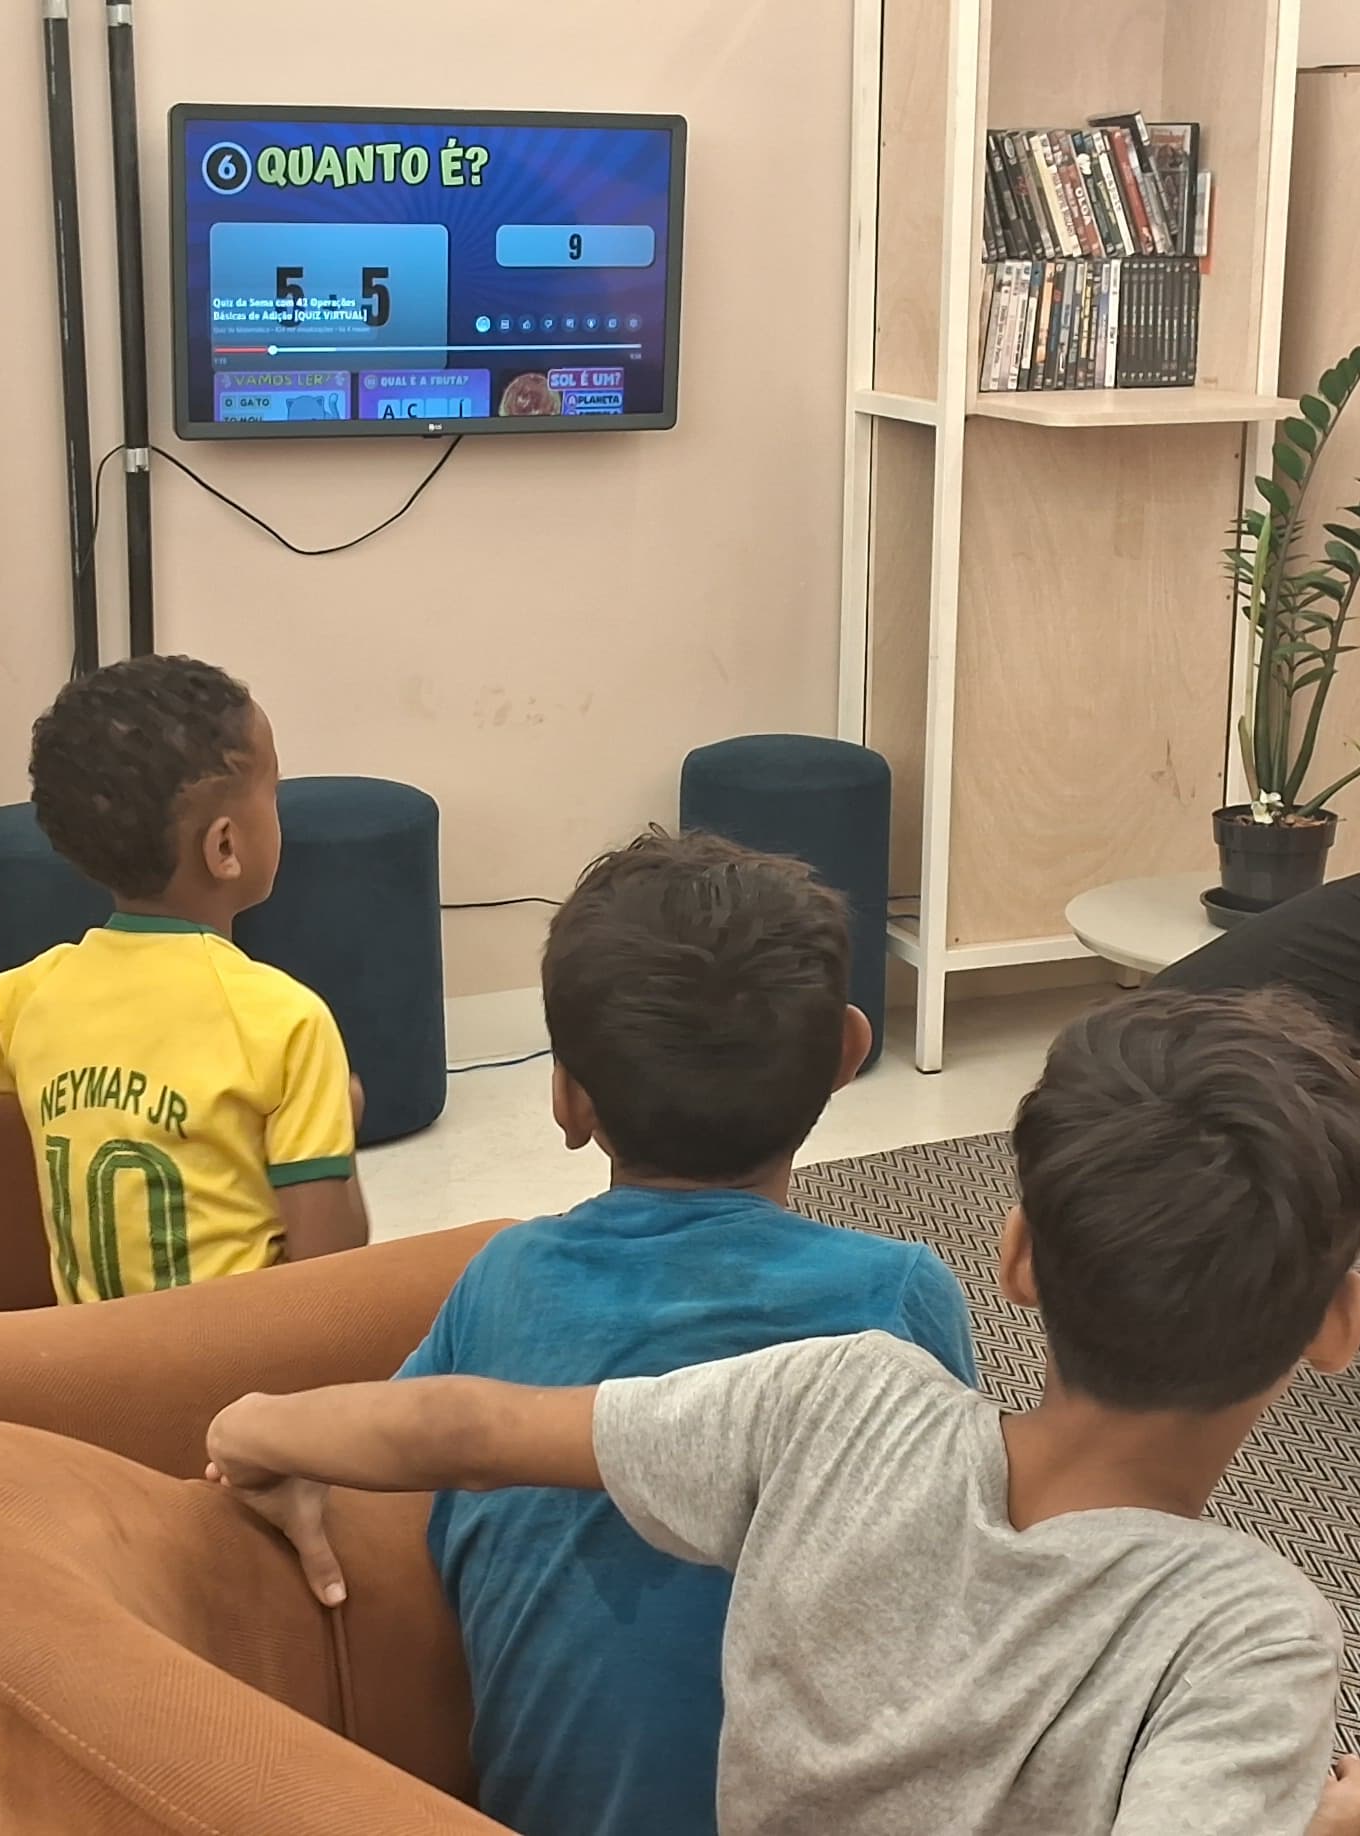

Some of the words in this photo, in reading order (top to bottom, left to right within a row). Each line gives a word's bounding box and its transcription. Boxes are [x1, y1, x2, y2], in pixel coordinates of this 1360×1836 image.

[218, 156, 236, 179] 6
[256, 141, 429, 188] QUANTO
[441, 138, 490, 187] É?
[569, 233, 582, 261] 9
[213, 298, 234, 308] Quiz
[275, 299, 294, 308] com
[310, 297, 356, 310] Operações
[275, 266, 304, 327] 5
[362, 266, 391, 327] 5
[213, 310, 246, 321] Básicas
[248, 311, 260, 321] de
[262, 310, 292, 322] Adição
[294, 310, 321, 322] [QUIZ
[324, 310, 368, 322] VIRTUAL]
[234, 375, 292, 386] VAMOS
[381, 375, 407, 387] QUAL
[420, 375, 426, 385] A
[430, 375, 469, 386] FRUTA?
[550, 373, 576, 387] SOL
[580, 370, 589, 386] É
[593, 372, 621, 386] UM?
[577, 395, 620, 404] PLANETA
[383, 404, 395, 418] A
[407, 403, 417, 418] C
[40, 1066, 147, 1127] NEYMAR
[147, 1085, 189, 1140] JR
[46, 1134, 192, 1304] 10
